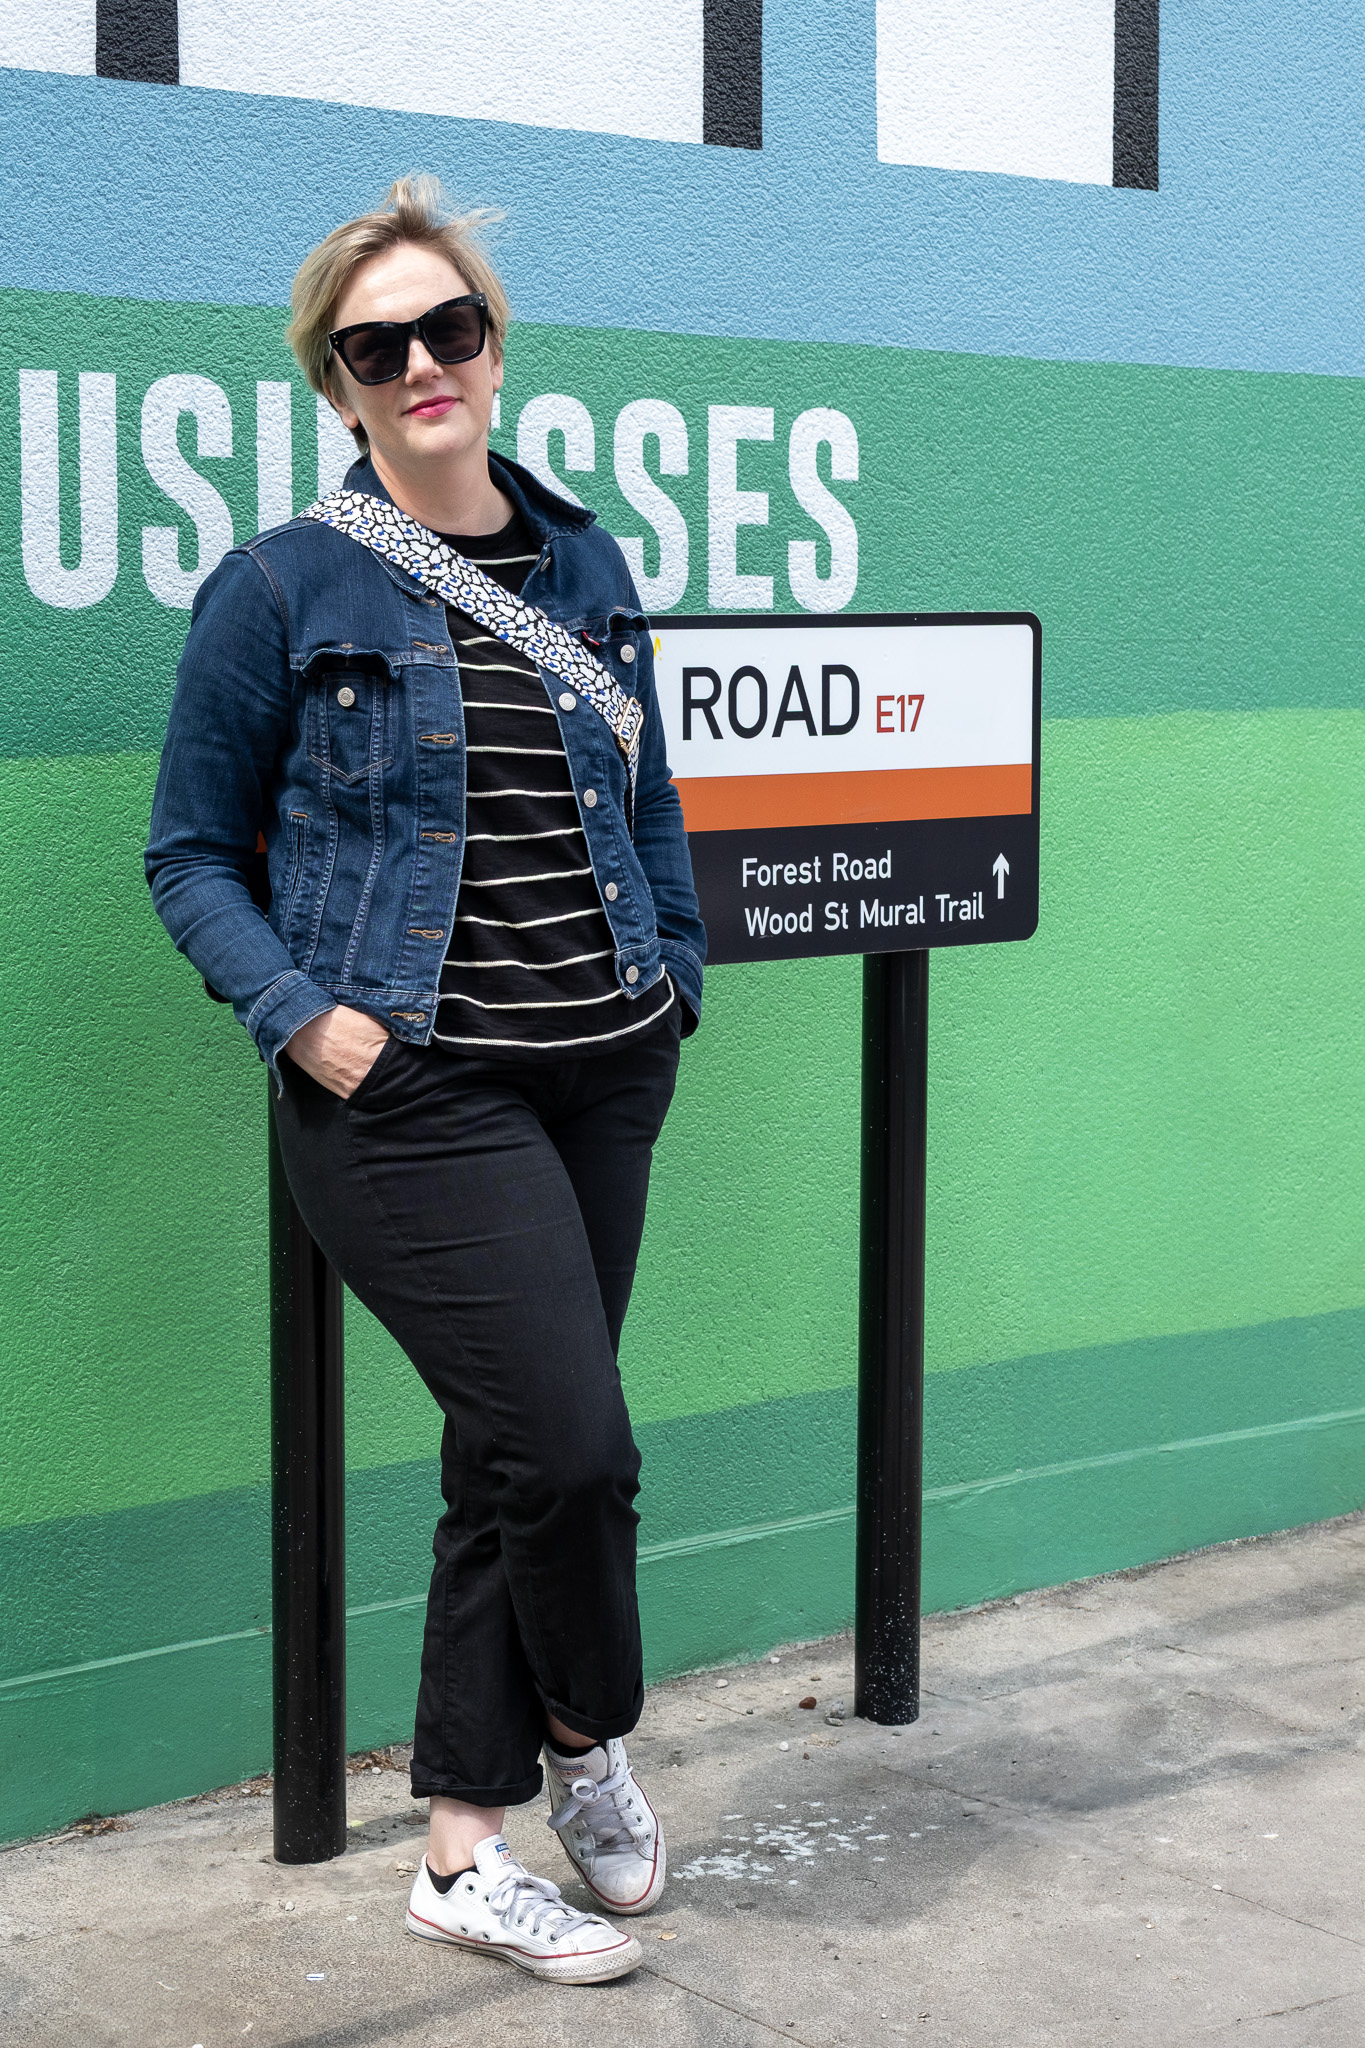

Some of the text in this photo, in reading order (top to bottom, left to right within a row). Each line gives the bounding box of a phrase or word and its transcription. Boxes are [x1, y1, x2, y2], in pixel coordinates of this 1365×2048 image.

[18, 368, 860, 614] USISSES
[682, 664, 925, 741] ROAD E17
[742, 850, 892, 887] Forest Road
[744, 891, 985, 937] Wood St Mural Trail
